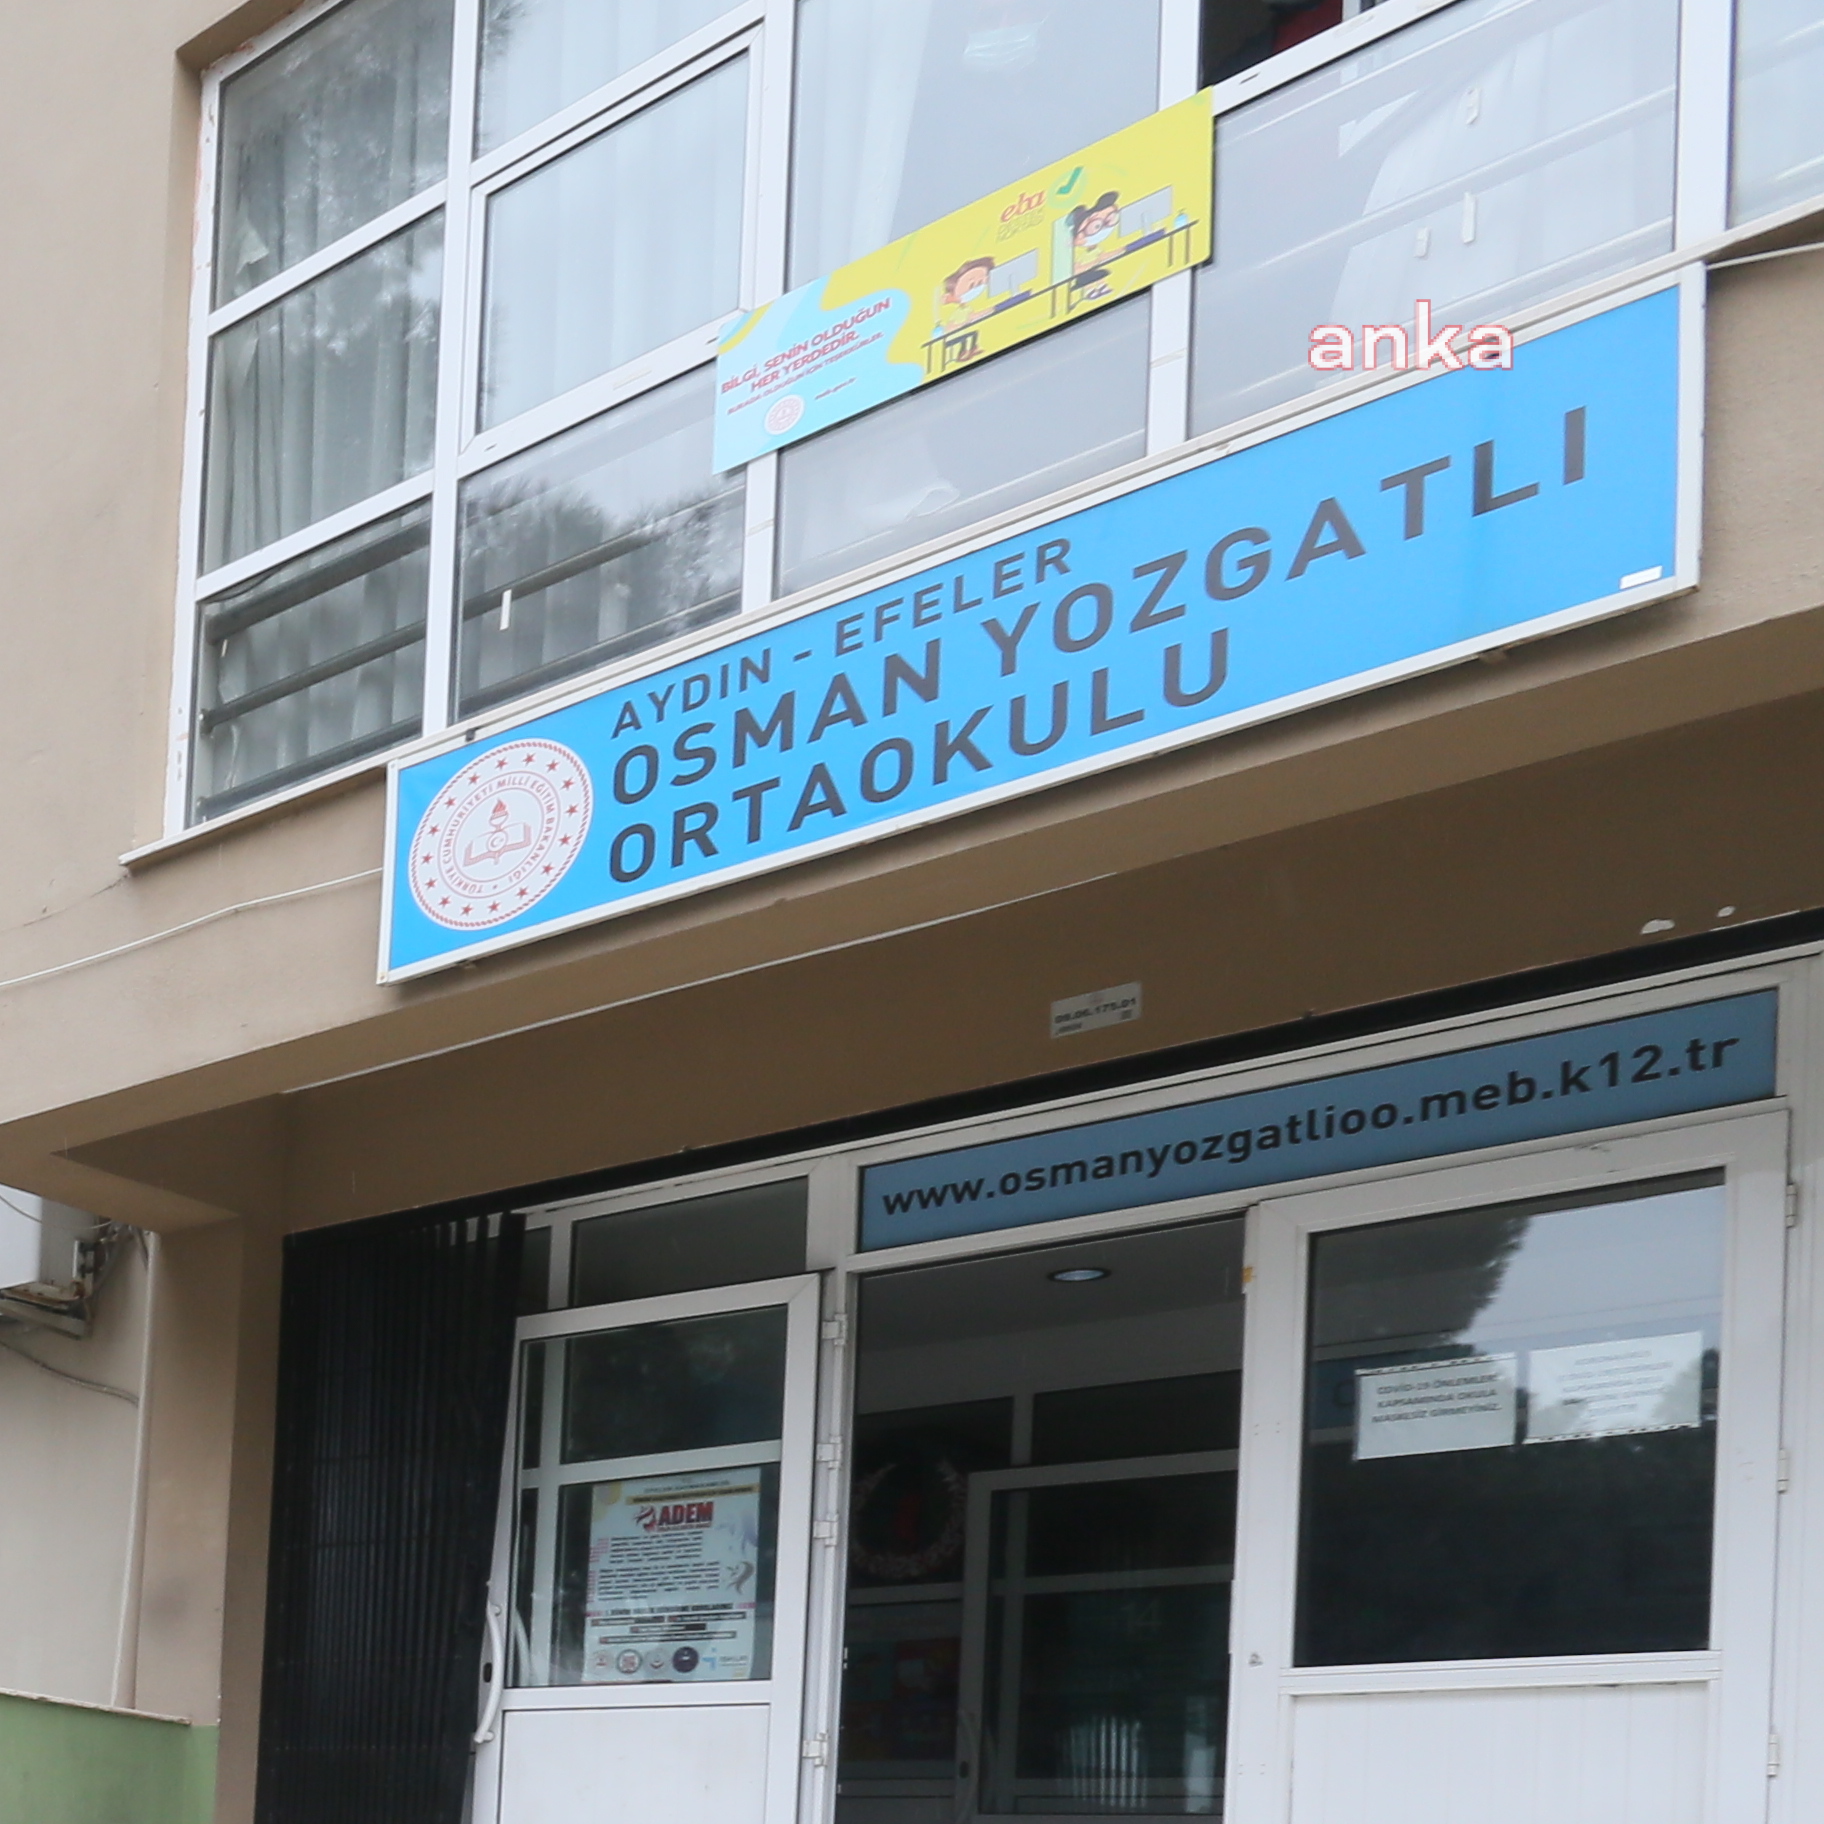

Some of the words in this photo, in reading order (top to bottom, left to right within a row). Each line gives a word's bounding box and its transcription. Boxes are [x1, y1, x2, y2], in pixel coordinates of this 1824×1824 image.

[764, 340, 808, 372] SENİN
[811, 297, 892, 347] OLDUĞUN
[750, 369, 780, 392] HER
[611, 648, 772, 739] AYDIN
[793, 649, 812, 663] -
[834, 538, 1072, 657] EFELER
[613, 638, 942, 805] OSMAN
[981, 405, 1587, 678] YOZGATLI
[497, 776, 531, 788] MİLLİ
[609, 628, 1230, 884] ORTAOKULU
[442, 784, 493, 864] CUMHURİYETİ
[530, 780, 555, 814] EĞİTİM
[508, 817, 555, 882] BAKANLIĞI
[882, 1037, 1740, 1216] www.osmanyozgatlioo.meb.k12.tr
[658, 1502, 714, 1526] ADEM
